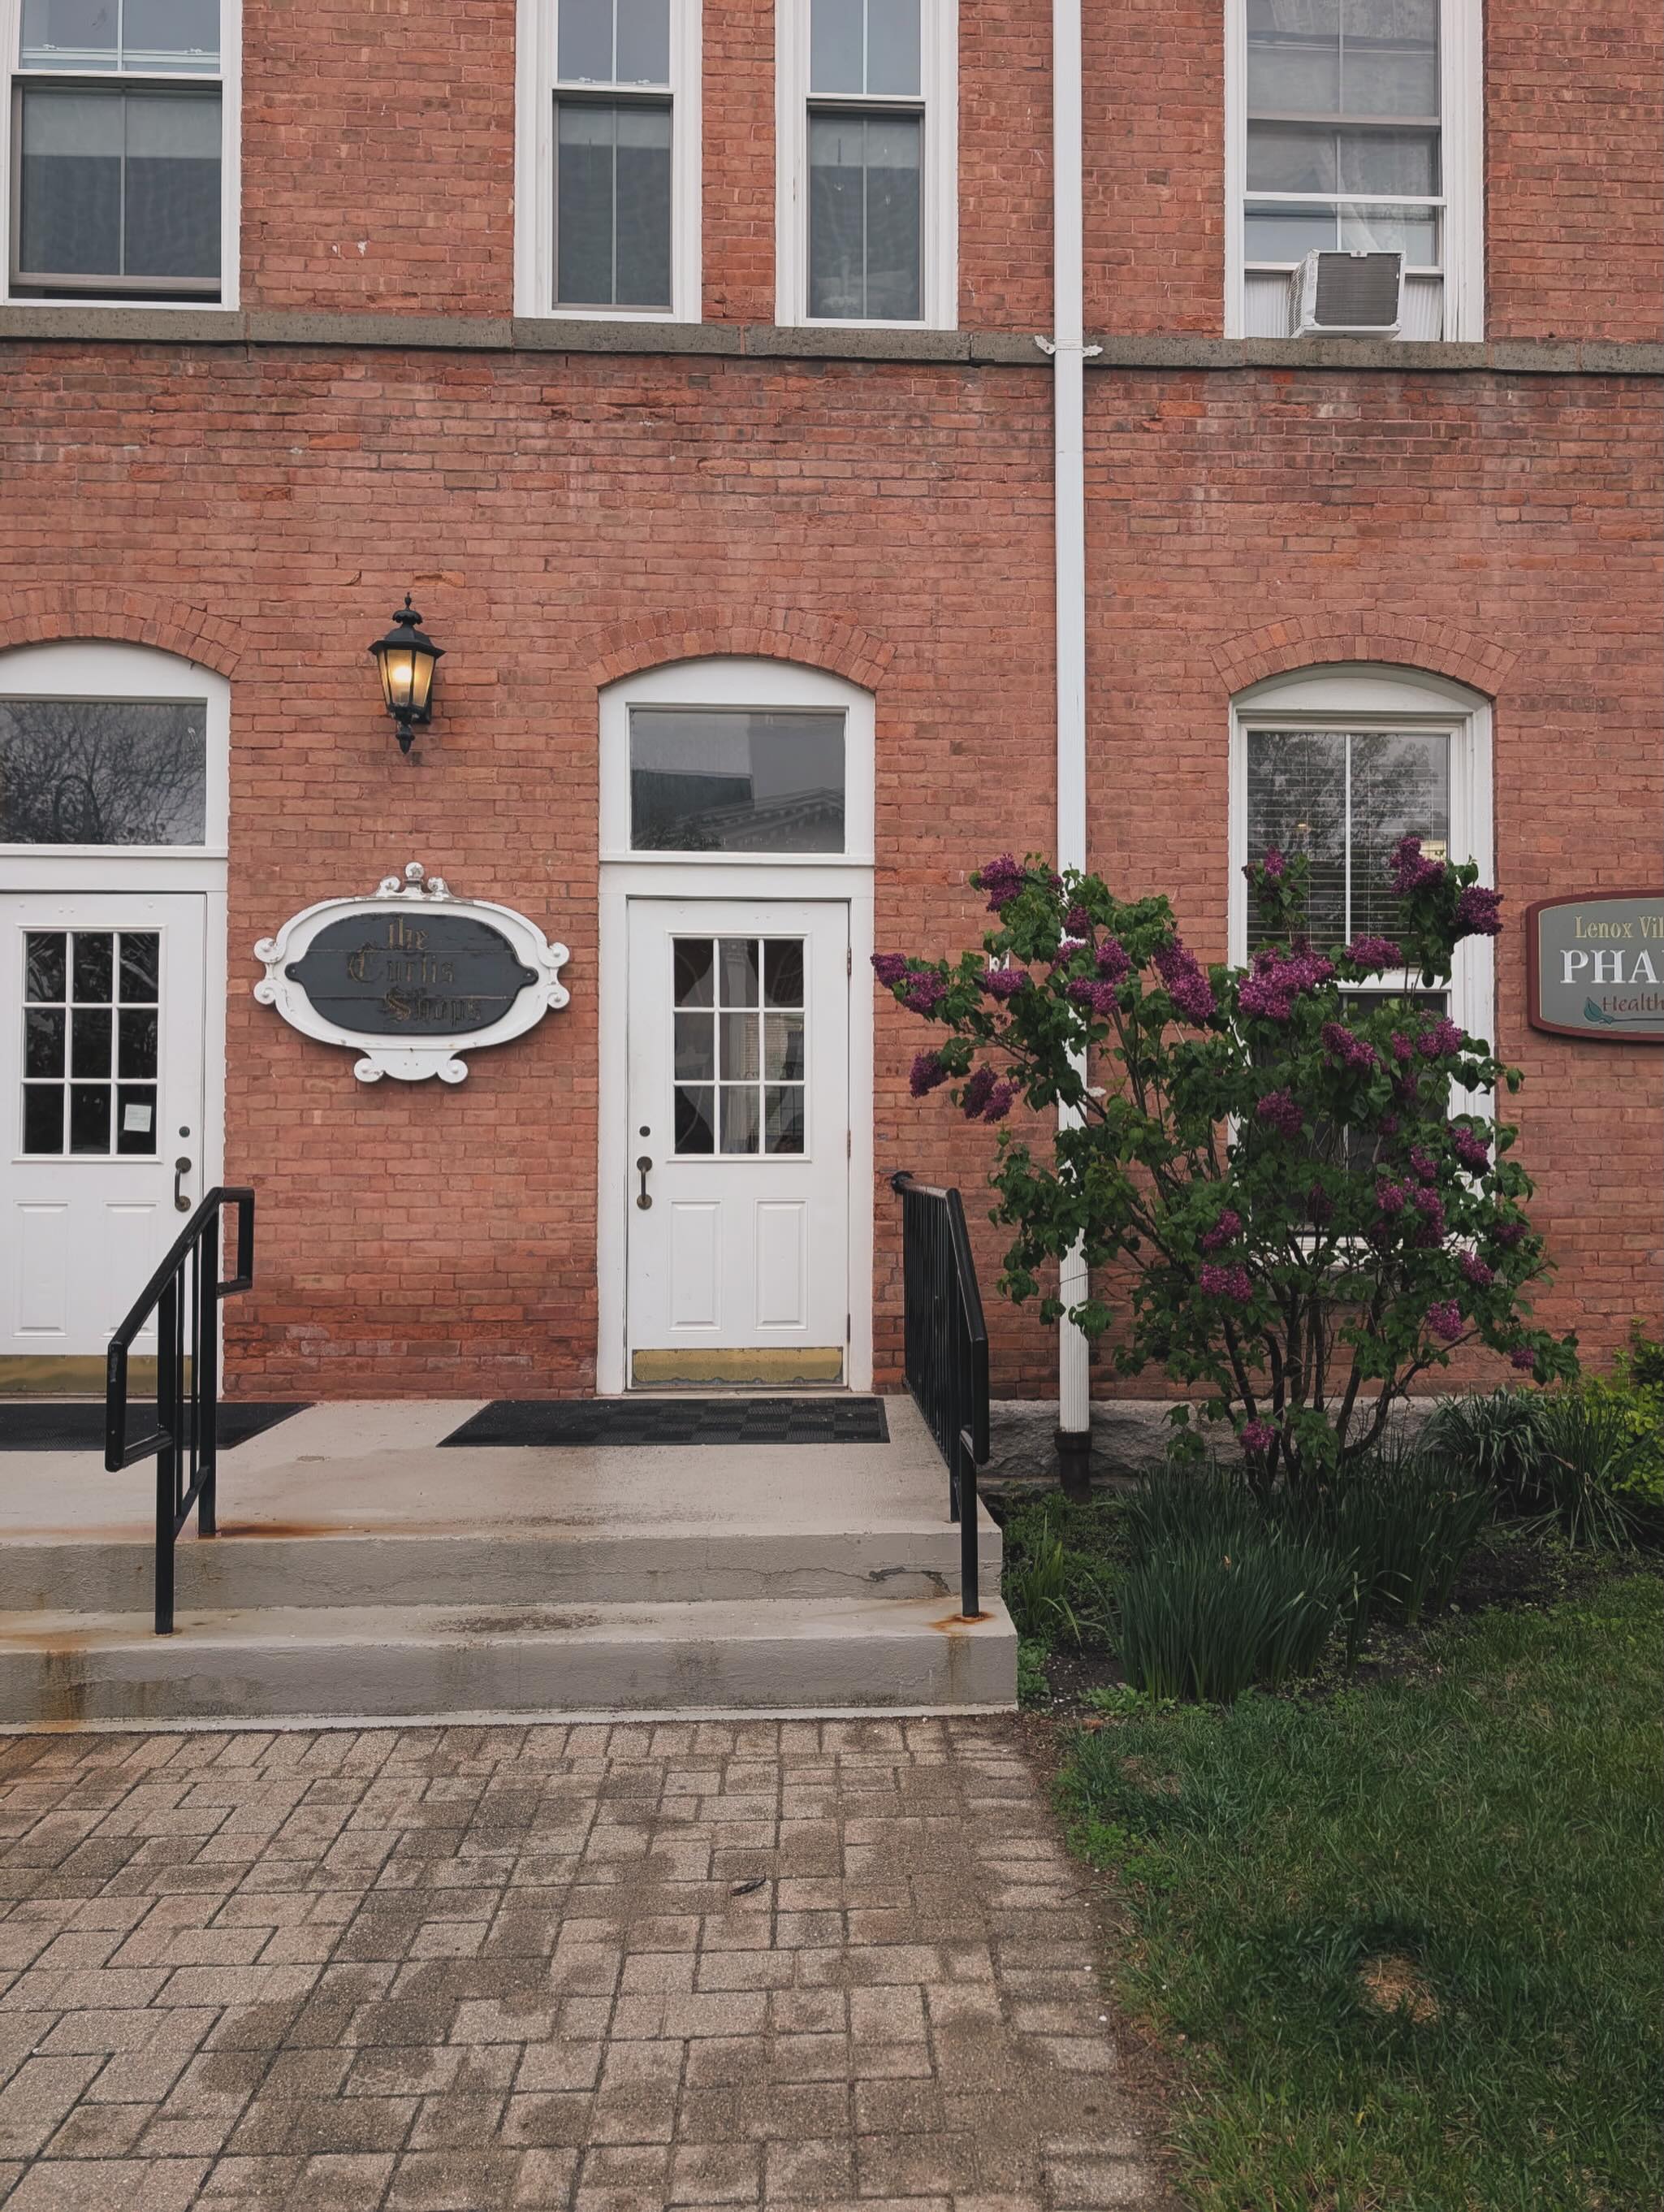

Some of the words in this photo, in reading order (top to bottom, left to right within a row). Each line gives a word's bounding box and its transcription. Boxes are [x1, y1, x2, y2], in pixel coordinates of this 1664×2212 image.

[1574, 916, 1634, 938] Lenox
[349, 942, 454, 983] Curtis
[1559, 949, 1664, 984] PHA
[378, 985, 482, 1027] Shops
[1602, 992, 1664, 1012] Health
